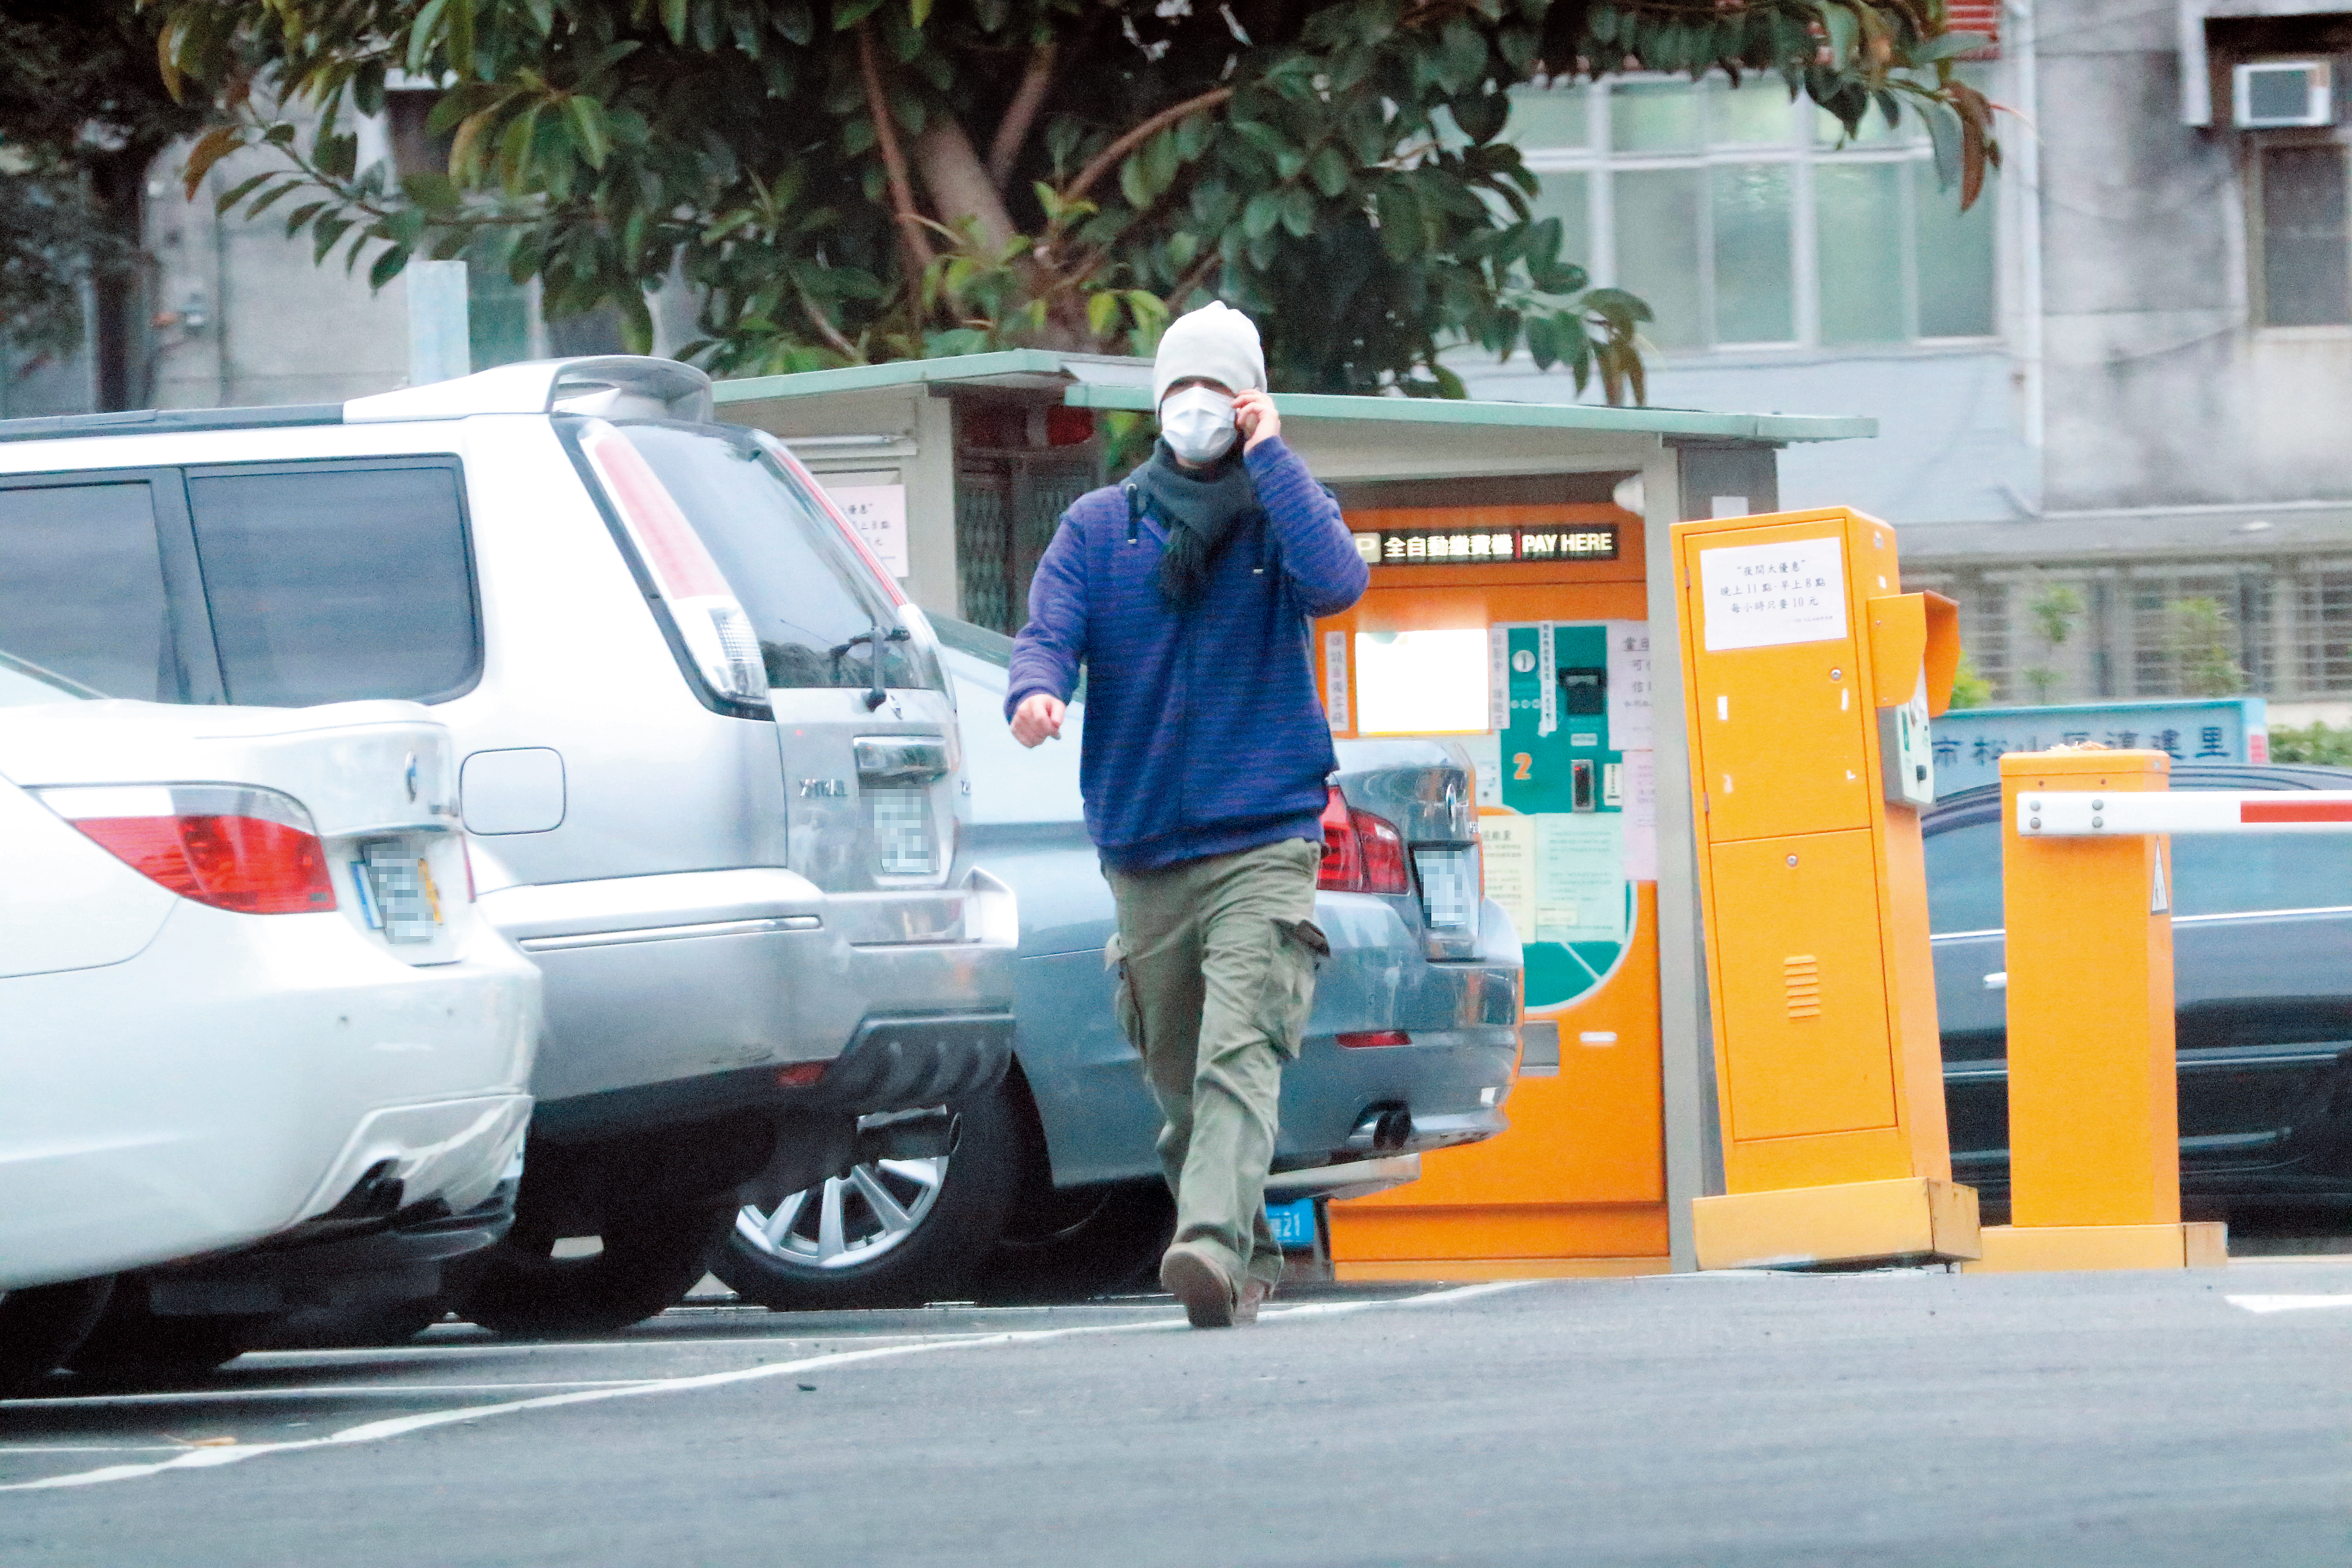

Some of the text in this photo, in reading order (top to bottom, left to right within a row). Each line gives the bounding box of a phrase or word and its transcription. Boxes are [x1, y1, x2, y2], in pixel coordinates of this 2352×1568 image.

[1522, 533, 1612, 552] PAY HERE
[1513, 752, 1532, 780] 2
